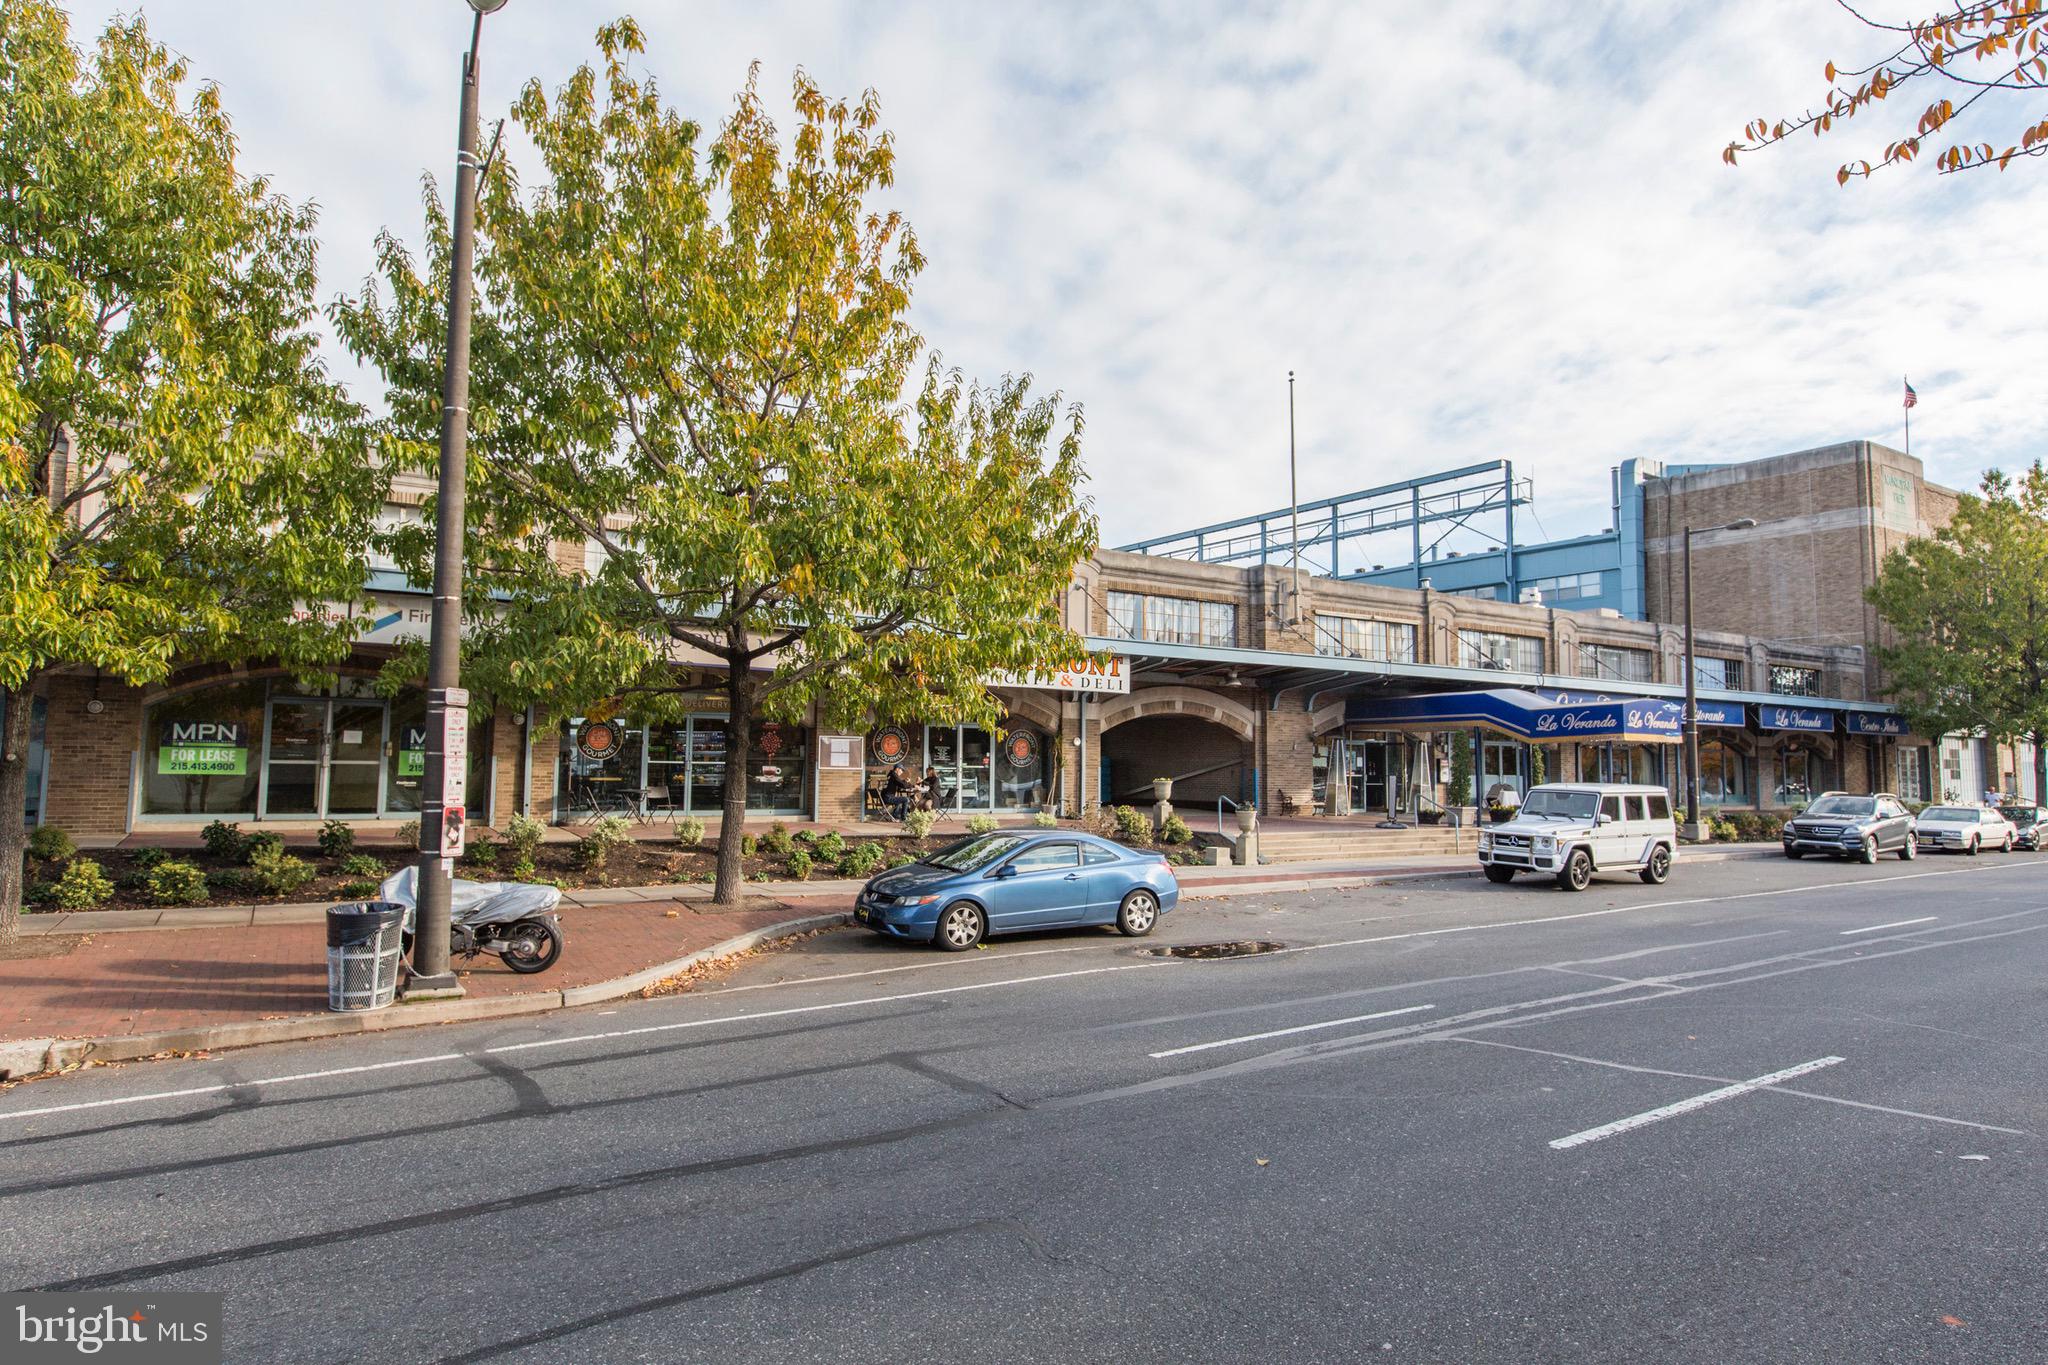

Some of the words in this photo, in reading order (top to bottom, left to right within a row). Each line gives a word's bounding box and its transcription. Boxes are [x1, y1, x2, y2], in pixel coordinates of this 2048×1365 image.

[1060, 674, 1073, 687] &
[1081, 677, 1122, 690] DELI
[1536, 713, 1558, 731] La
[1561, 711, 1617, 730] Veranda
[1628, 710, 1643, 729] La
[1644, 711, 1678, 730] Veranda
[1775, 708, 1789, 726] La
[1790, 709, 1822, 728] Veranda
[173, 723, 237, 740] MPN
[171, 749, 196, 761] FOR
[200, 749, 236, 762] LEASE
[582, 744, 617, 758] GOURMET
[170, 762, 235, 771] 215.413.4900
